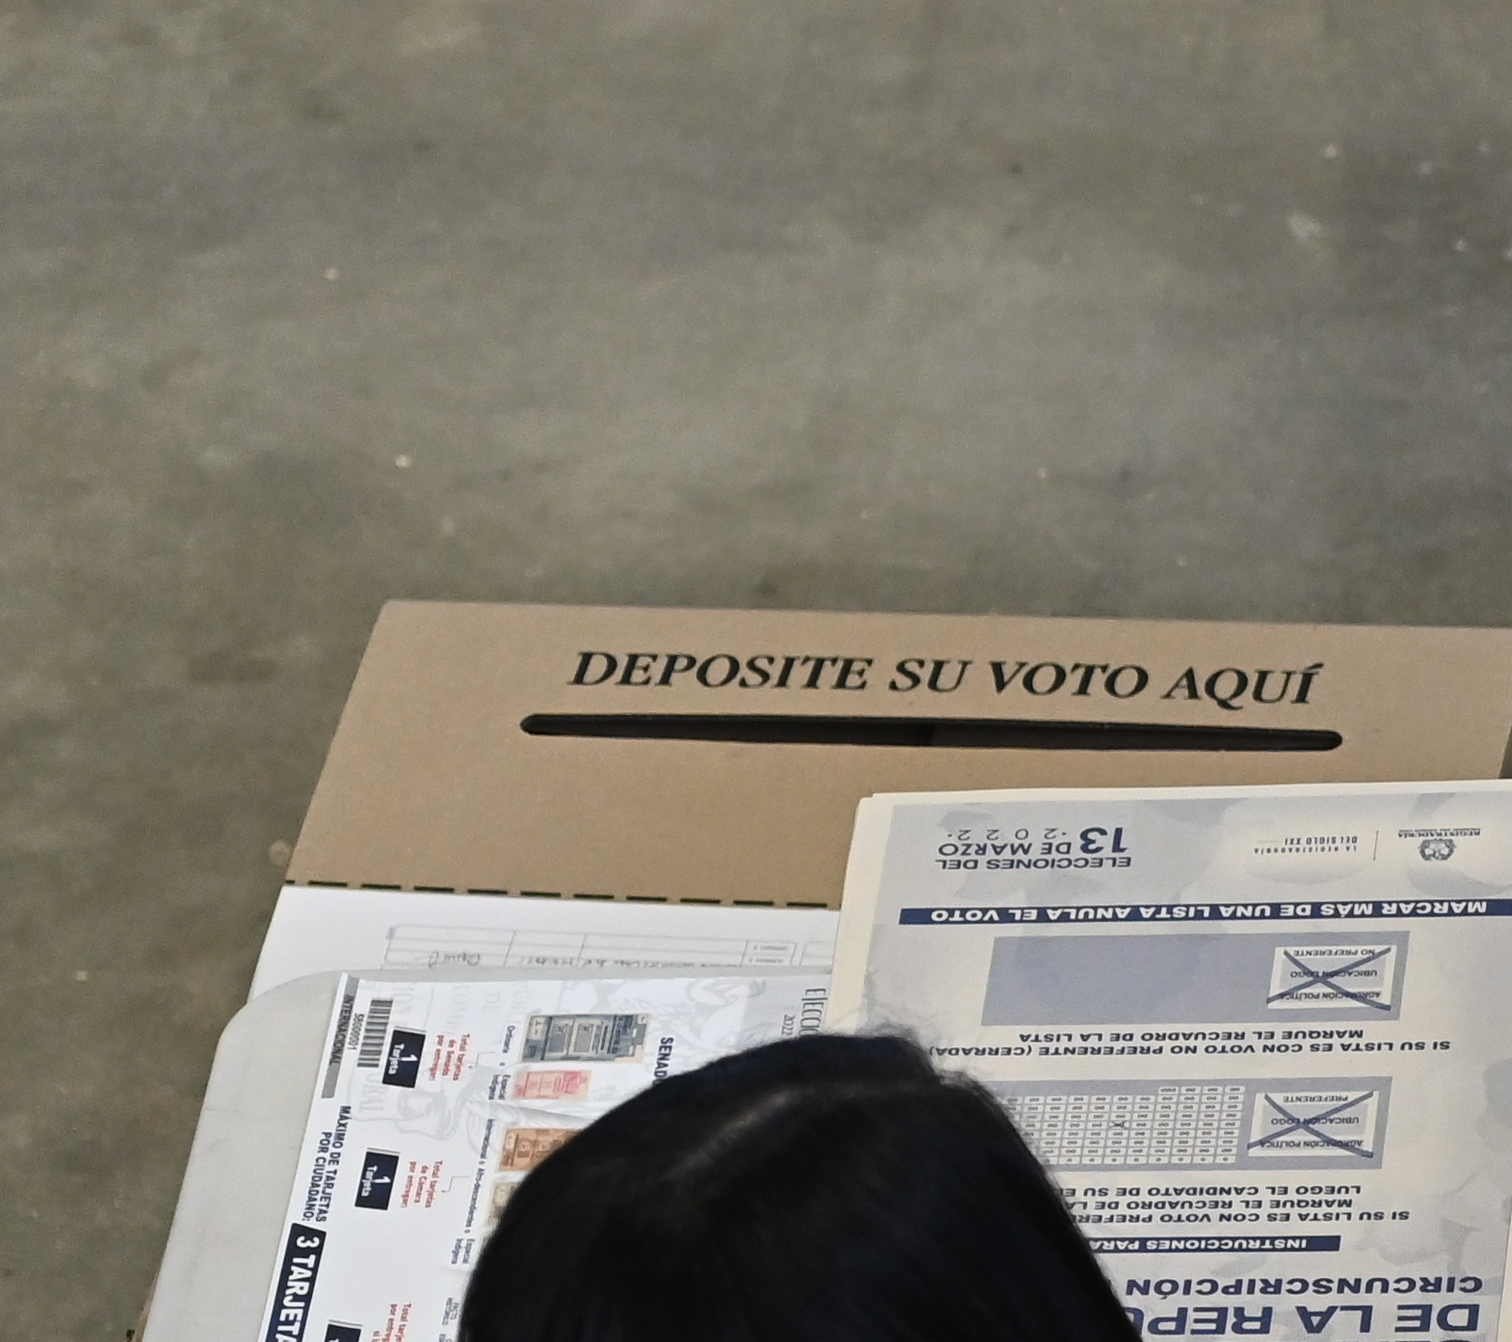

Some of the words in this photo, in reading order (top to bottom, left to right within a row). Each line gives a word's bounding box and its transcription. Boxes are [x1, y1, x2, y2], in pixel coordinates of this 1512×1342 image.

[567, 650, 873, 691] DEPOSITE
[888, 658, 973, 694] SU
[990, 660, 1149, 698] VOTO
[1163, 662, 1325, 711] AQUÍ
[1080, 828, 1126, 854] 13
[939, 843, 1032, 856] MARZO
[1041, 842, 1072, 855] DE
[936, 859, 979, 870] DEL
[987, 858, 1132, 870] ELECCIONES
[1047, 908, 1132, 920] ANULA
[1140, 907, 1210, 919] LISTA
[1219, 906, 1271, 917] UNA
[1280, 905, 1312, 916] DE
[1321, 904, 1373, 916] MÁS
[1382, 902, 1487, 915] MARCAR
[931, 910, 999, 922] VOTO
[1009, 909, 1038, 921] EL
[330, 994, 354, 1067] INTERNACIONAL
[781, 1014, 795, 1036] 2022
[1020, 1033, 1073, 1043] LISTA
[1080, 1033, 1103, 1042] LA
[1110, 1033, 1134, 1042] DE
[1141, 1031, 1246, 1041] RECUADRO
[1253, 1031, 1275, 1040] EL
[1282, 1030, 1364, 1040] MARQUE
[1039, 1045, 1164, 1056] PREFERENTE
[1171, 1045, 1198, 1054] NO
[1205, 1044, 1255, 1054] VOTO
[1263, 1043, 1303, 1053] CON
[1310, 1043, 1334, 1052] ES
[1340, 1042, 1394, 1052] LISTA
[1400, 1042, 1426, 1051] SU
[1433, 1041, 1451, 1050] SI
[389, 1042, 404, 1075] Tarjeta
[401, 1054, 417, 1062] 1
[332, 1104, 351, 1149] MÁXIMO
[317, 1130, 332, 1154] POR
[328, 1150, 341, 1167] DE
[362, 1164, 378, 1197] Tarjeta
[374, 1175, 391, 1184] 1
[303, 1155, 327, 1222] CIUDADANO:
[316, 1167, 337, 1223] TARJETAS
[296, 1233, 320, 1250] 3
[1147, 1240, 1307, 1249] INSTRUCCIONES
[1126, 1277, 1483, 1296] CIRCUNSCRIPCIÓN
[1297, 1306, 1373, 1334] LA
[1395, 1304, 1480, 1333] DE
